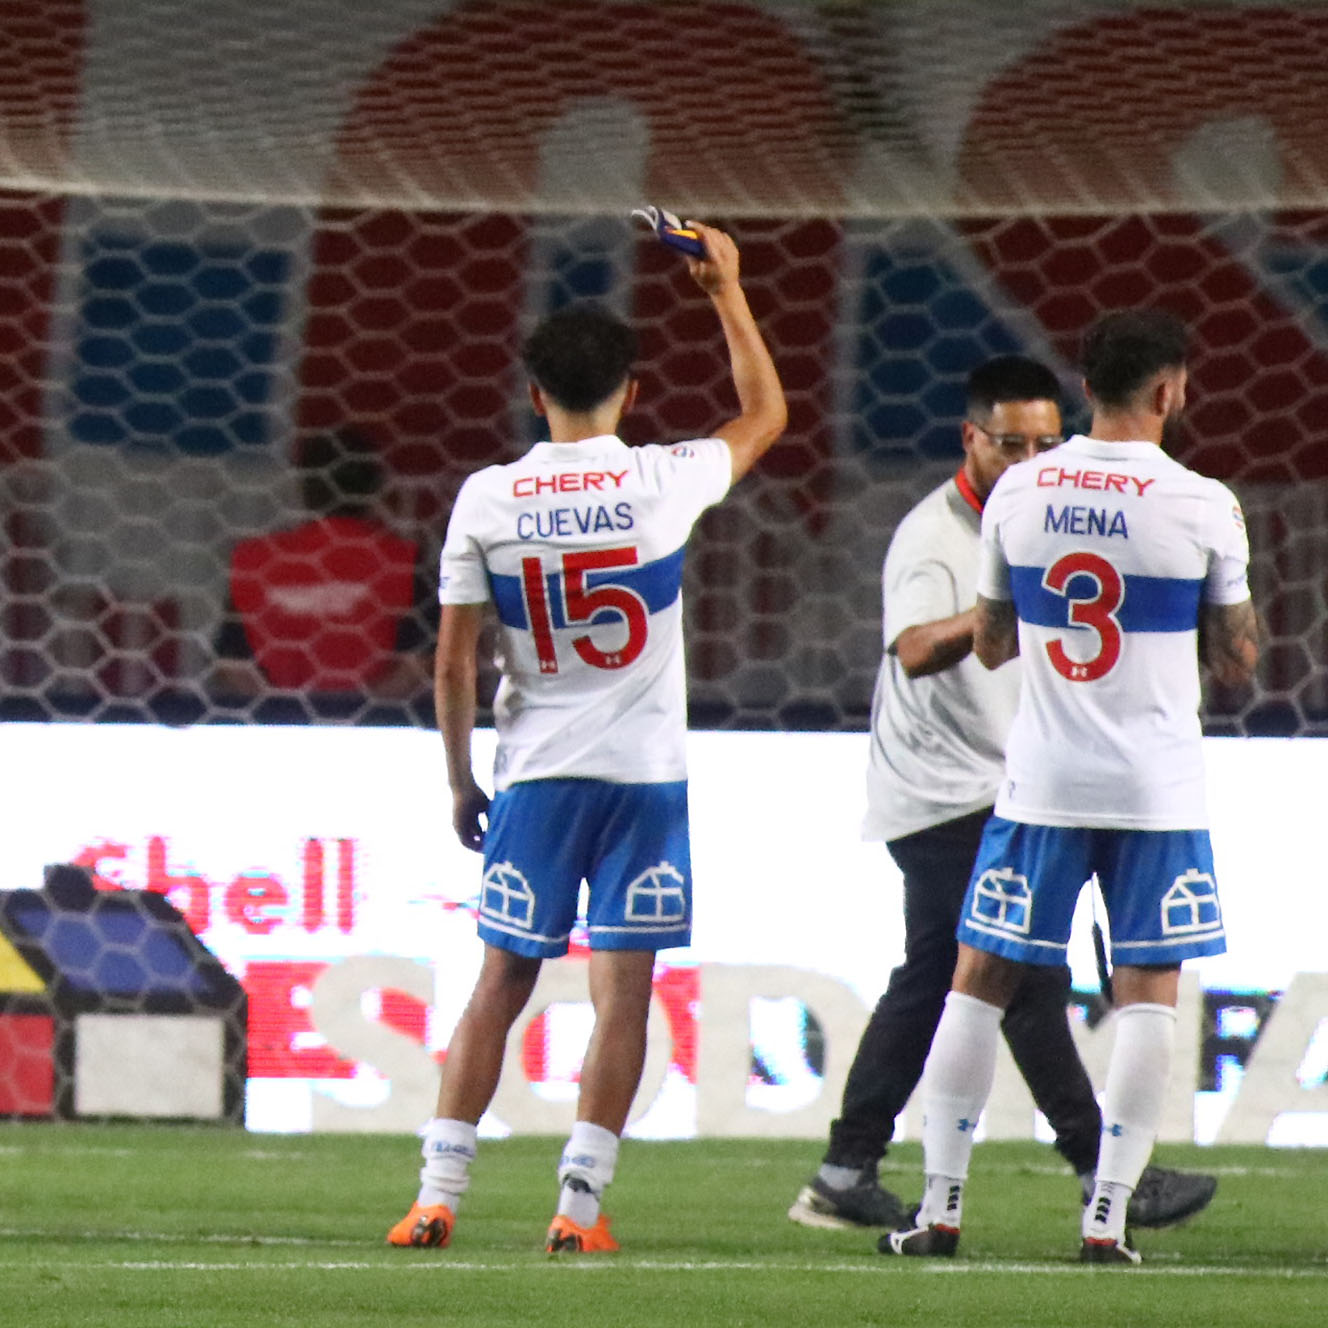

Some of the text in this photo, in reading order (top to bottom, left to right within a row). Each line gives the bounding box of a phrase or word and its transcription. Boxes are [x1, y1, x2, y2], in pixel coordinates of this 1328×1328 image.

[512, 470, 631, 498] CHERY
[1036, 467, 1157, 497] CHERY
[516, 502, 634, 540] CUEVAS
[1044, 503, 1129, 540] MENA
[520, 545, 649, 675] 15
[1041, 551, 1125, 682] 3
